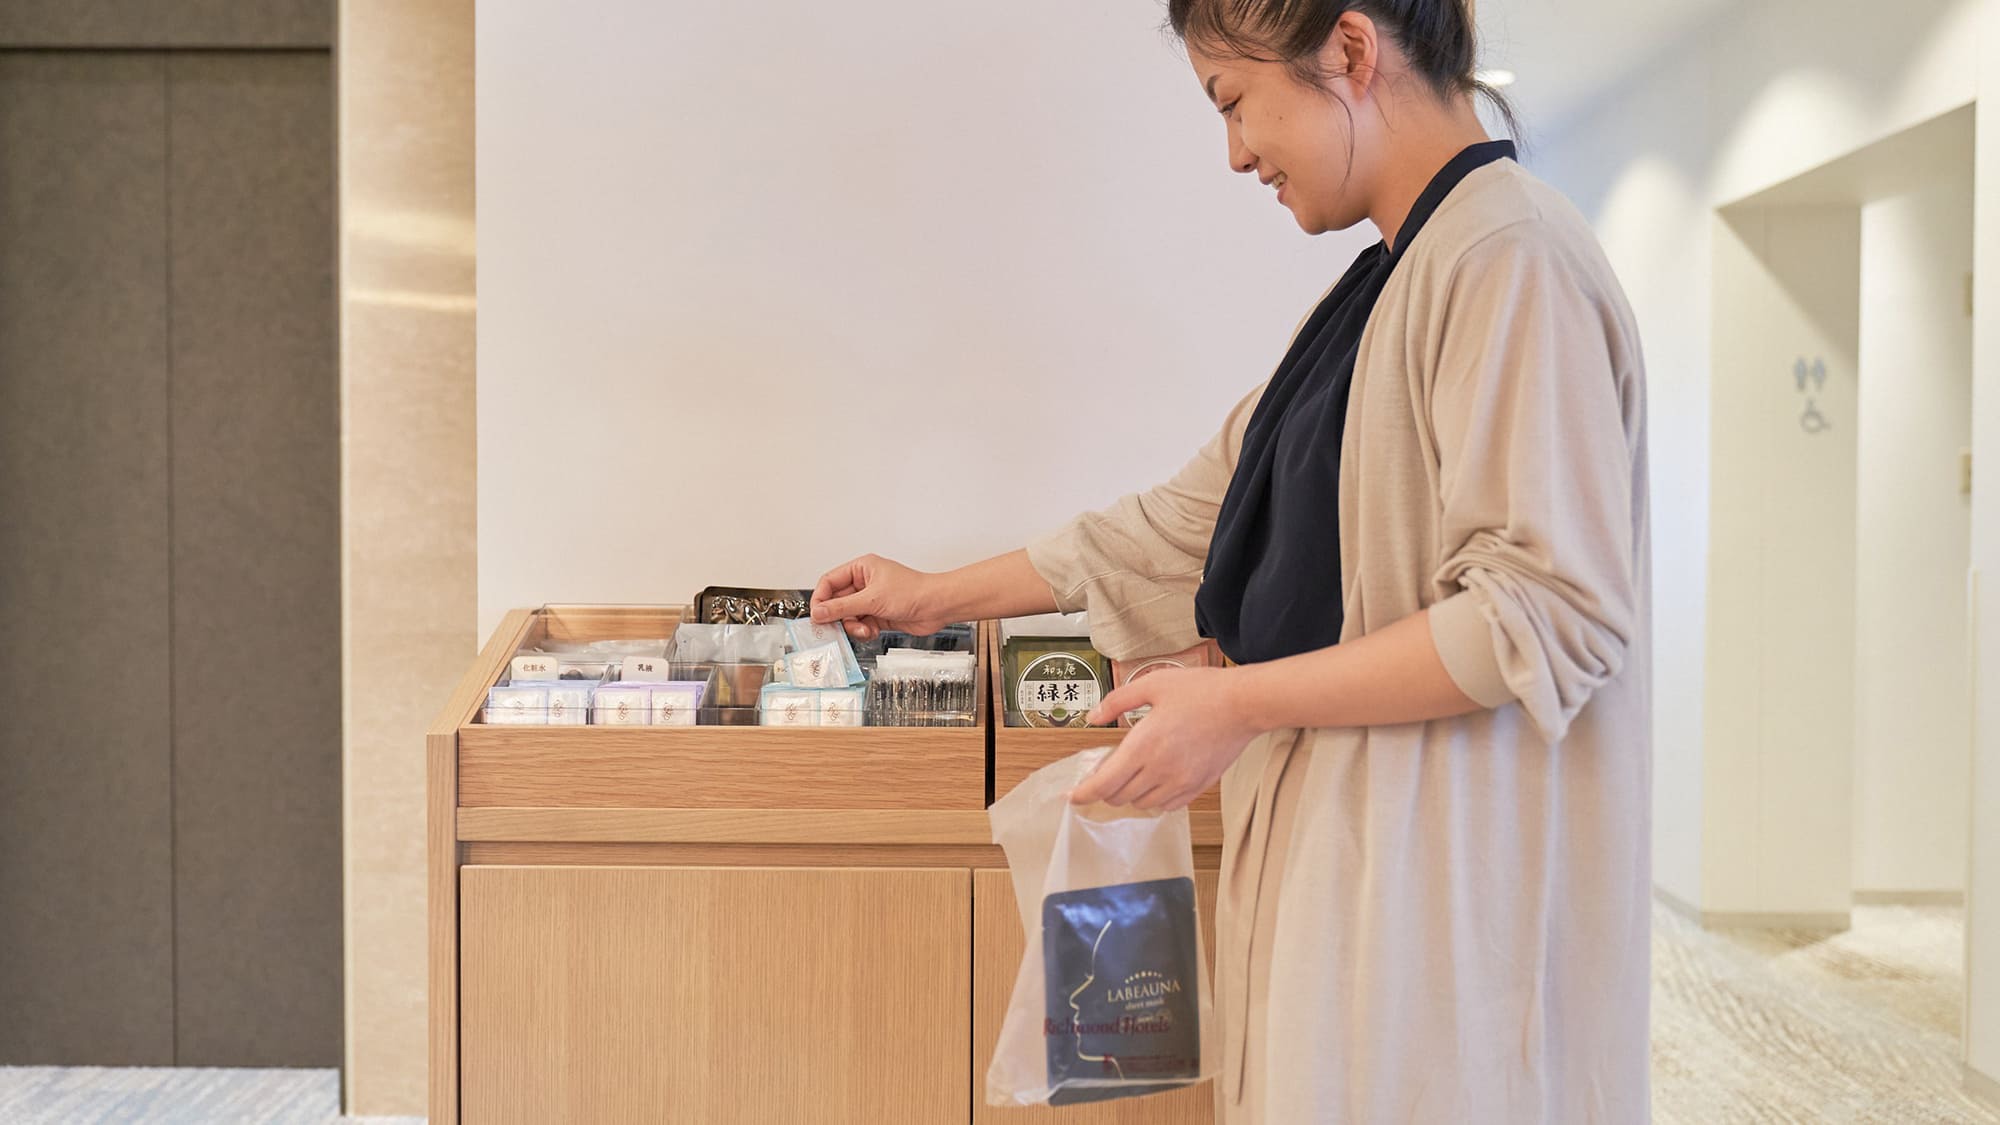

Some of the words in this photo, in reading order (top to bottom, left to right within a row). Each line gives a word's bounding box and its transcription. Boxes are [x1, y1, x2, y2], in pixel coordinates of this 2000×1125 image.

[523, 663, 546, 673] 化粧水
[637, 663, 653, 673] 乳液
[1037, 683, 1080, 702] 緑茶
[1107, 979, 1181, 1003] LABEAUNA
